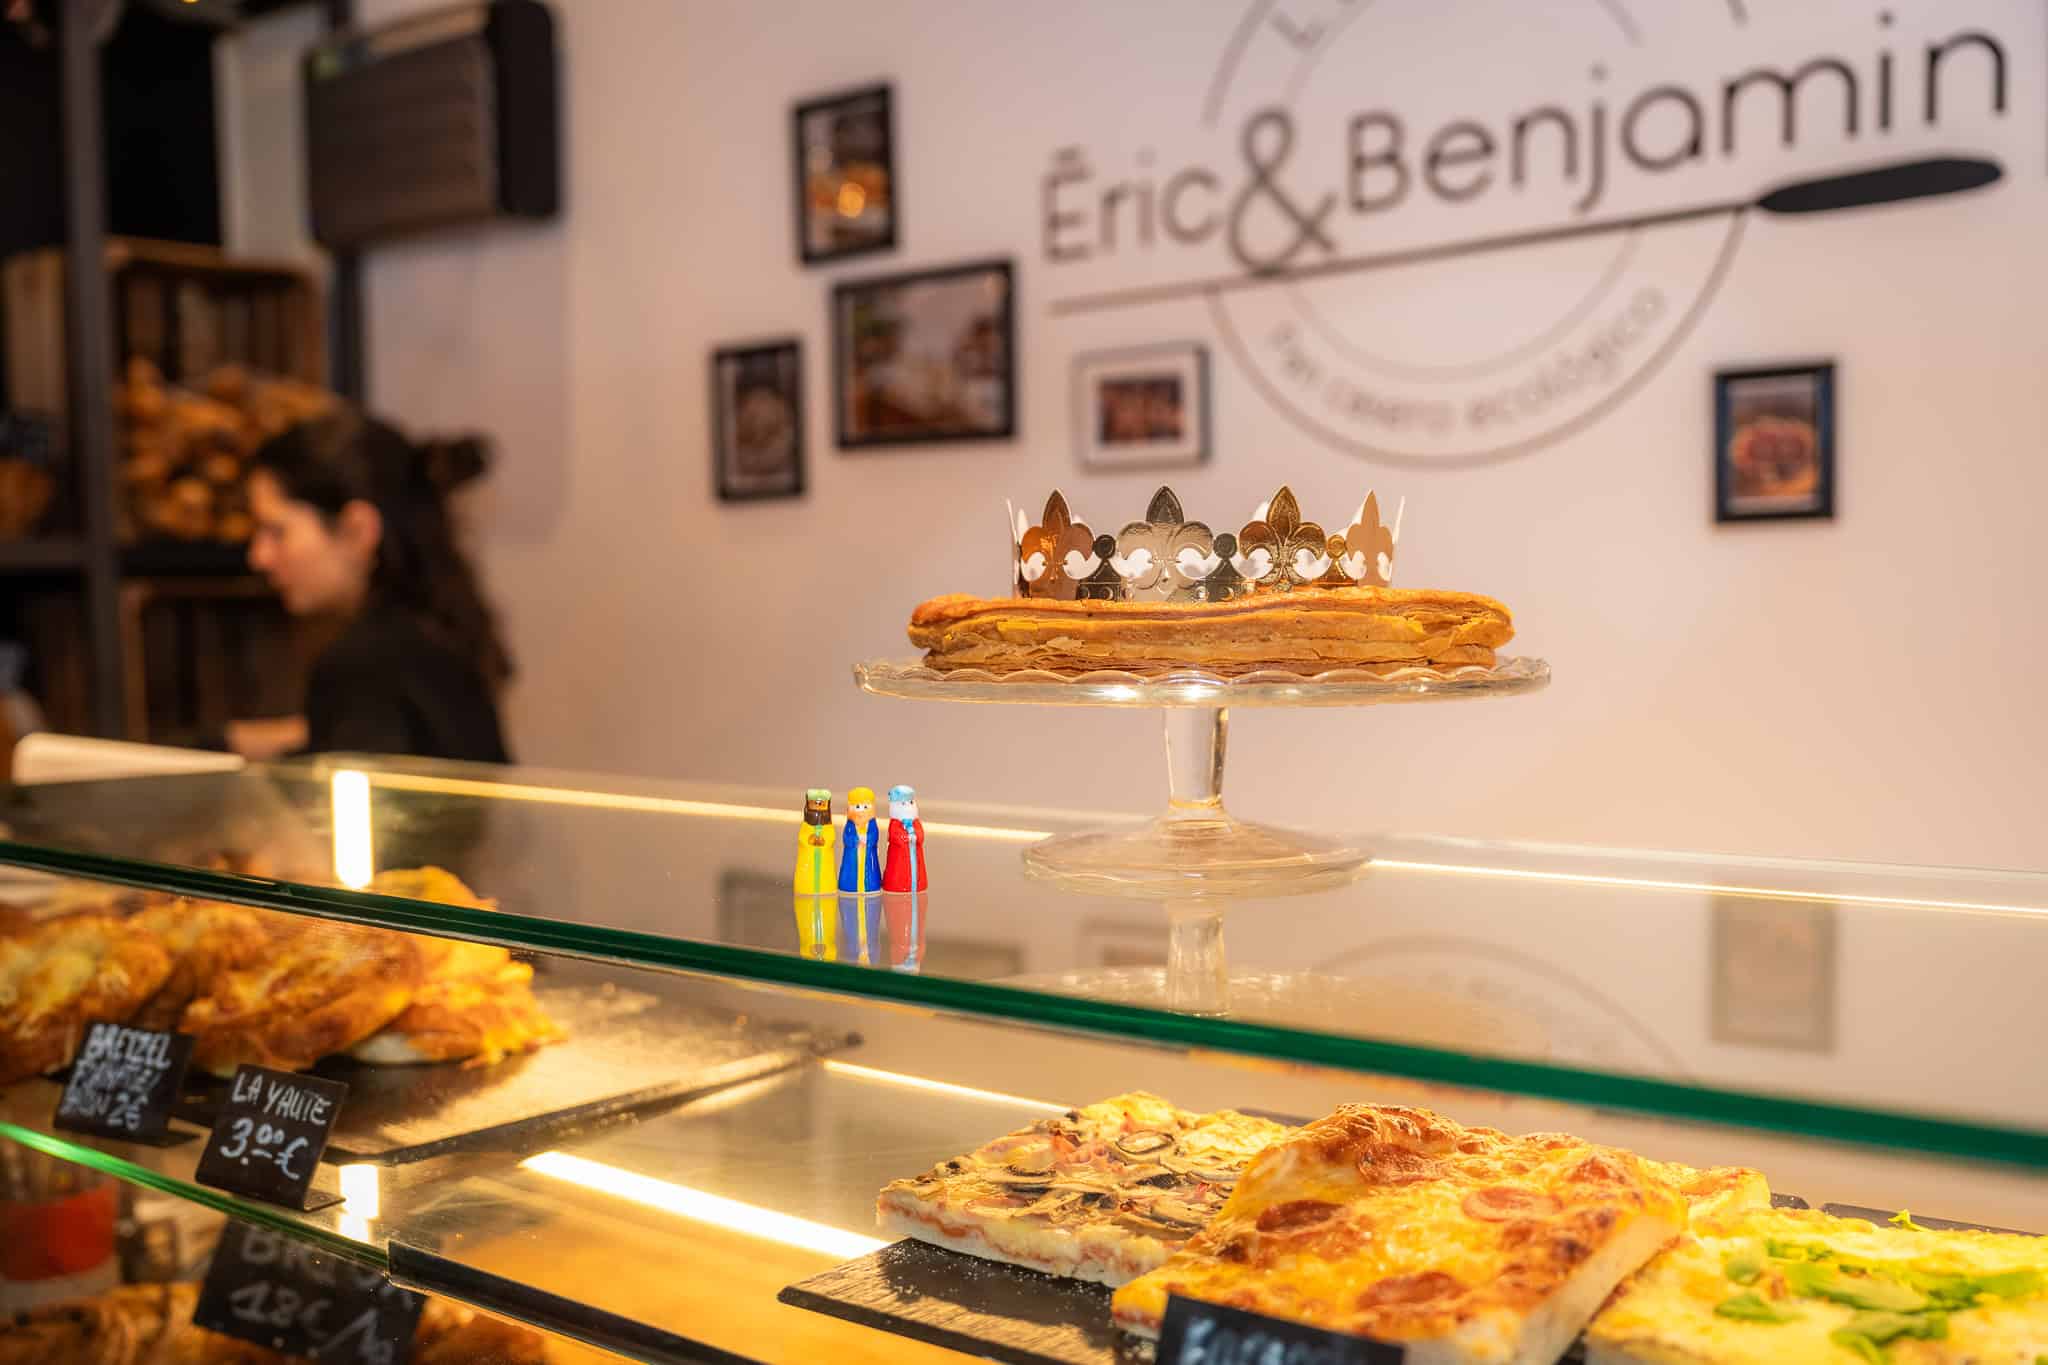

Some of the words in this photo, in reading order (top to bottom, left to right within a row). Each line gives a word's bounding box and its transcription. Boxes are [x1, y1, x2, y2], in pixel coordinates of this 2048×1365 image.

[1226, 104, 1340, 277] &
[1344, 10, 2008, 219] Benjamin
[231, 1072, 264, 1104] LA
